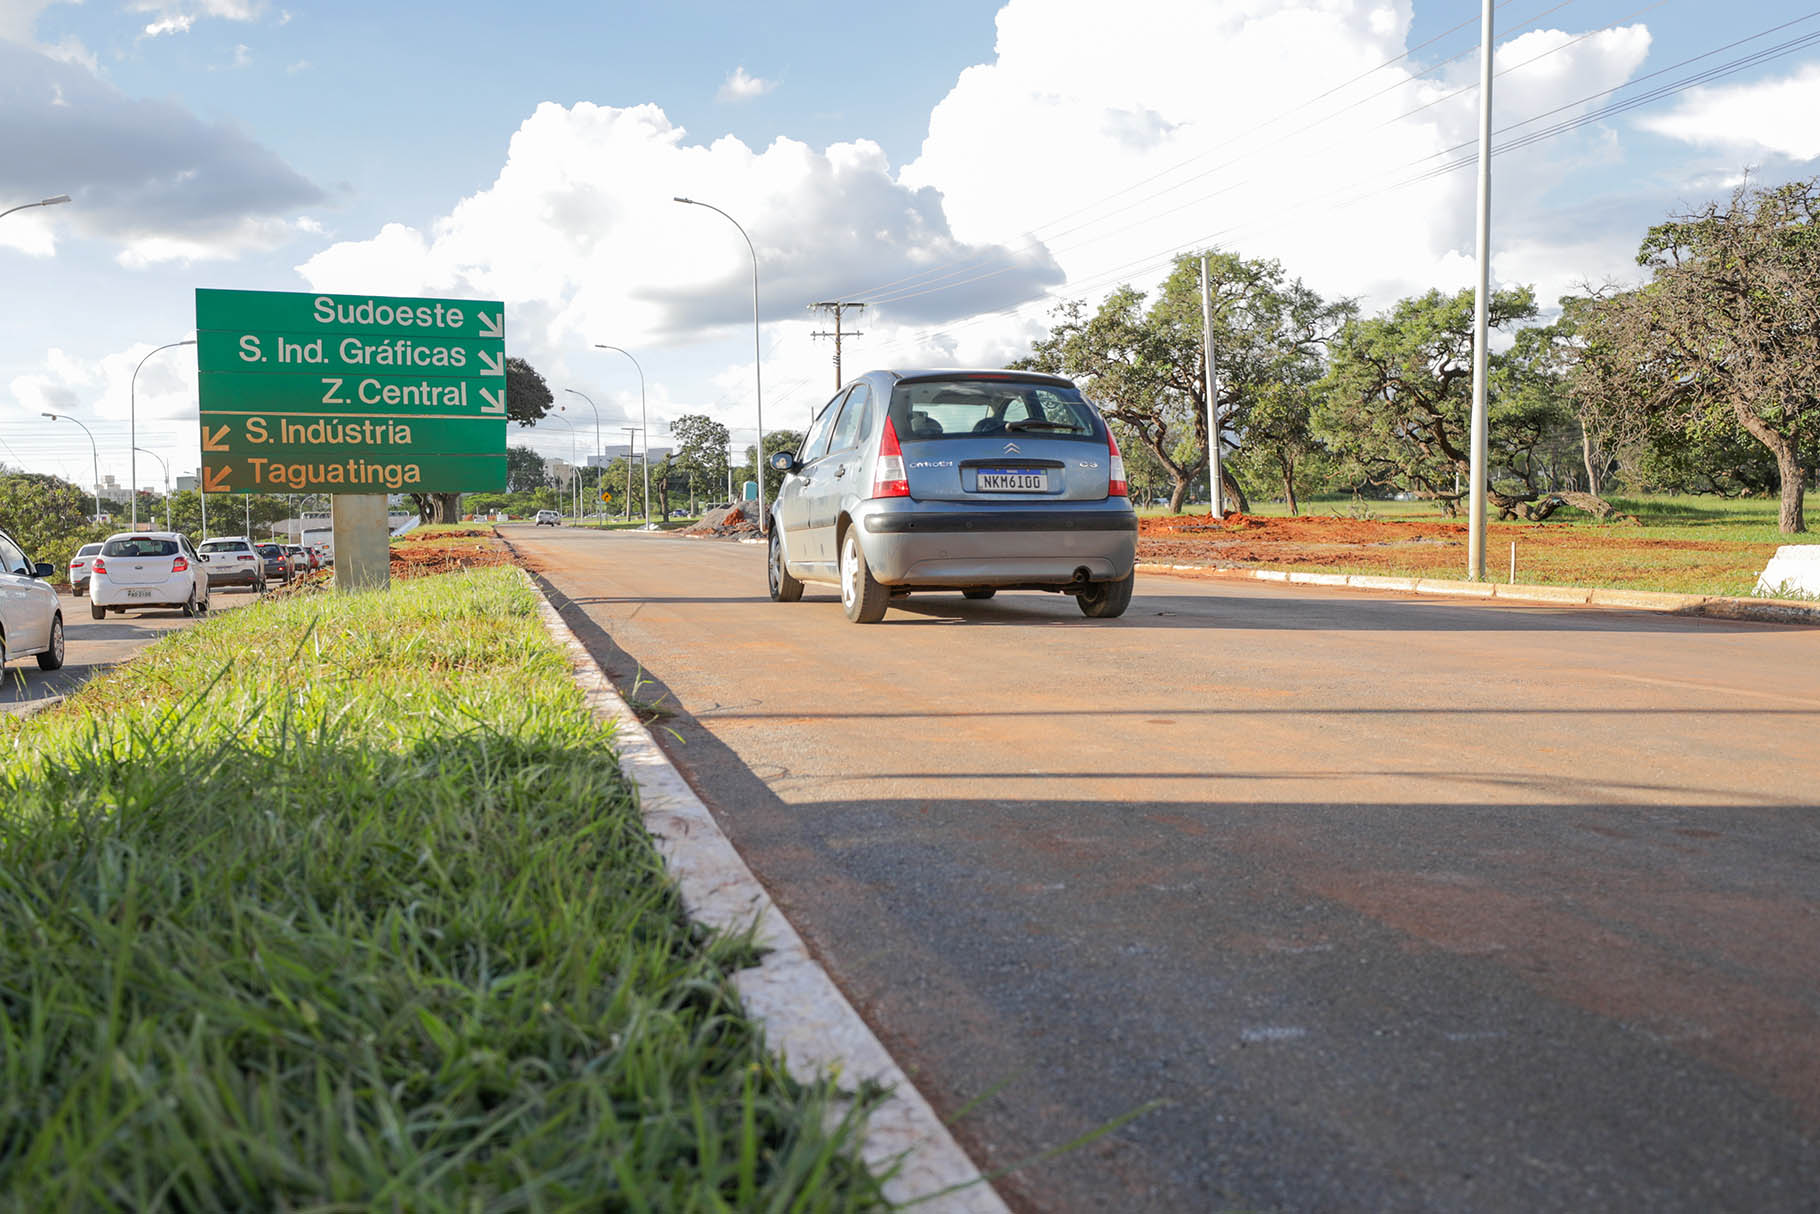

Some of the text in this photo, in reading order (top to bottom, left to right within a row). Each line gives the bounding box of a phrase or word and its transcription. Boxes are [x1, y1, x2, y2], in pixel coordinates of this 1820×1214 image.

[313, 296, 464, 328] Sudoeste
[238, 334, 467, 367] S. Ind. Gráficas
[321, 377, 467, 406] Z. Central
[245, 416, 413, 445] S. Indústria
[247, 457, 421, 490] Taguatinga
